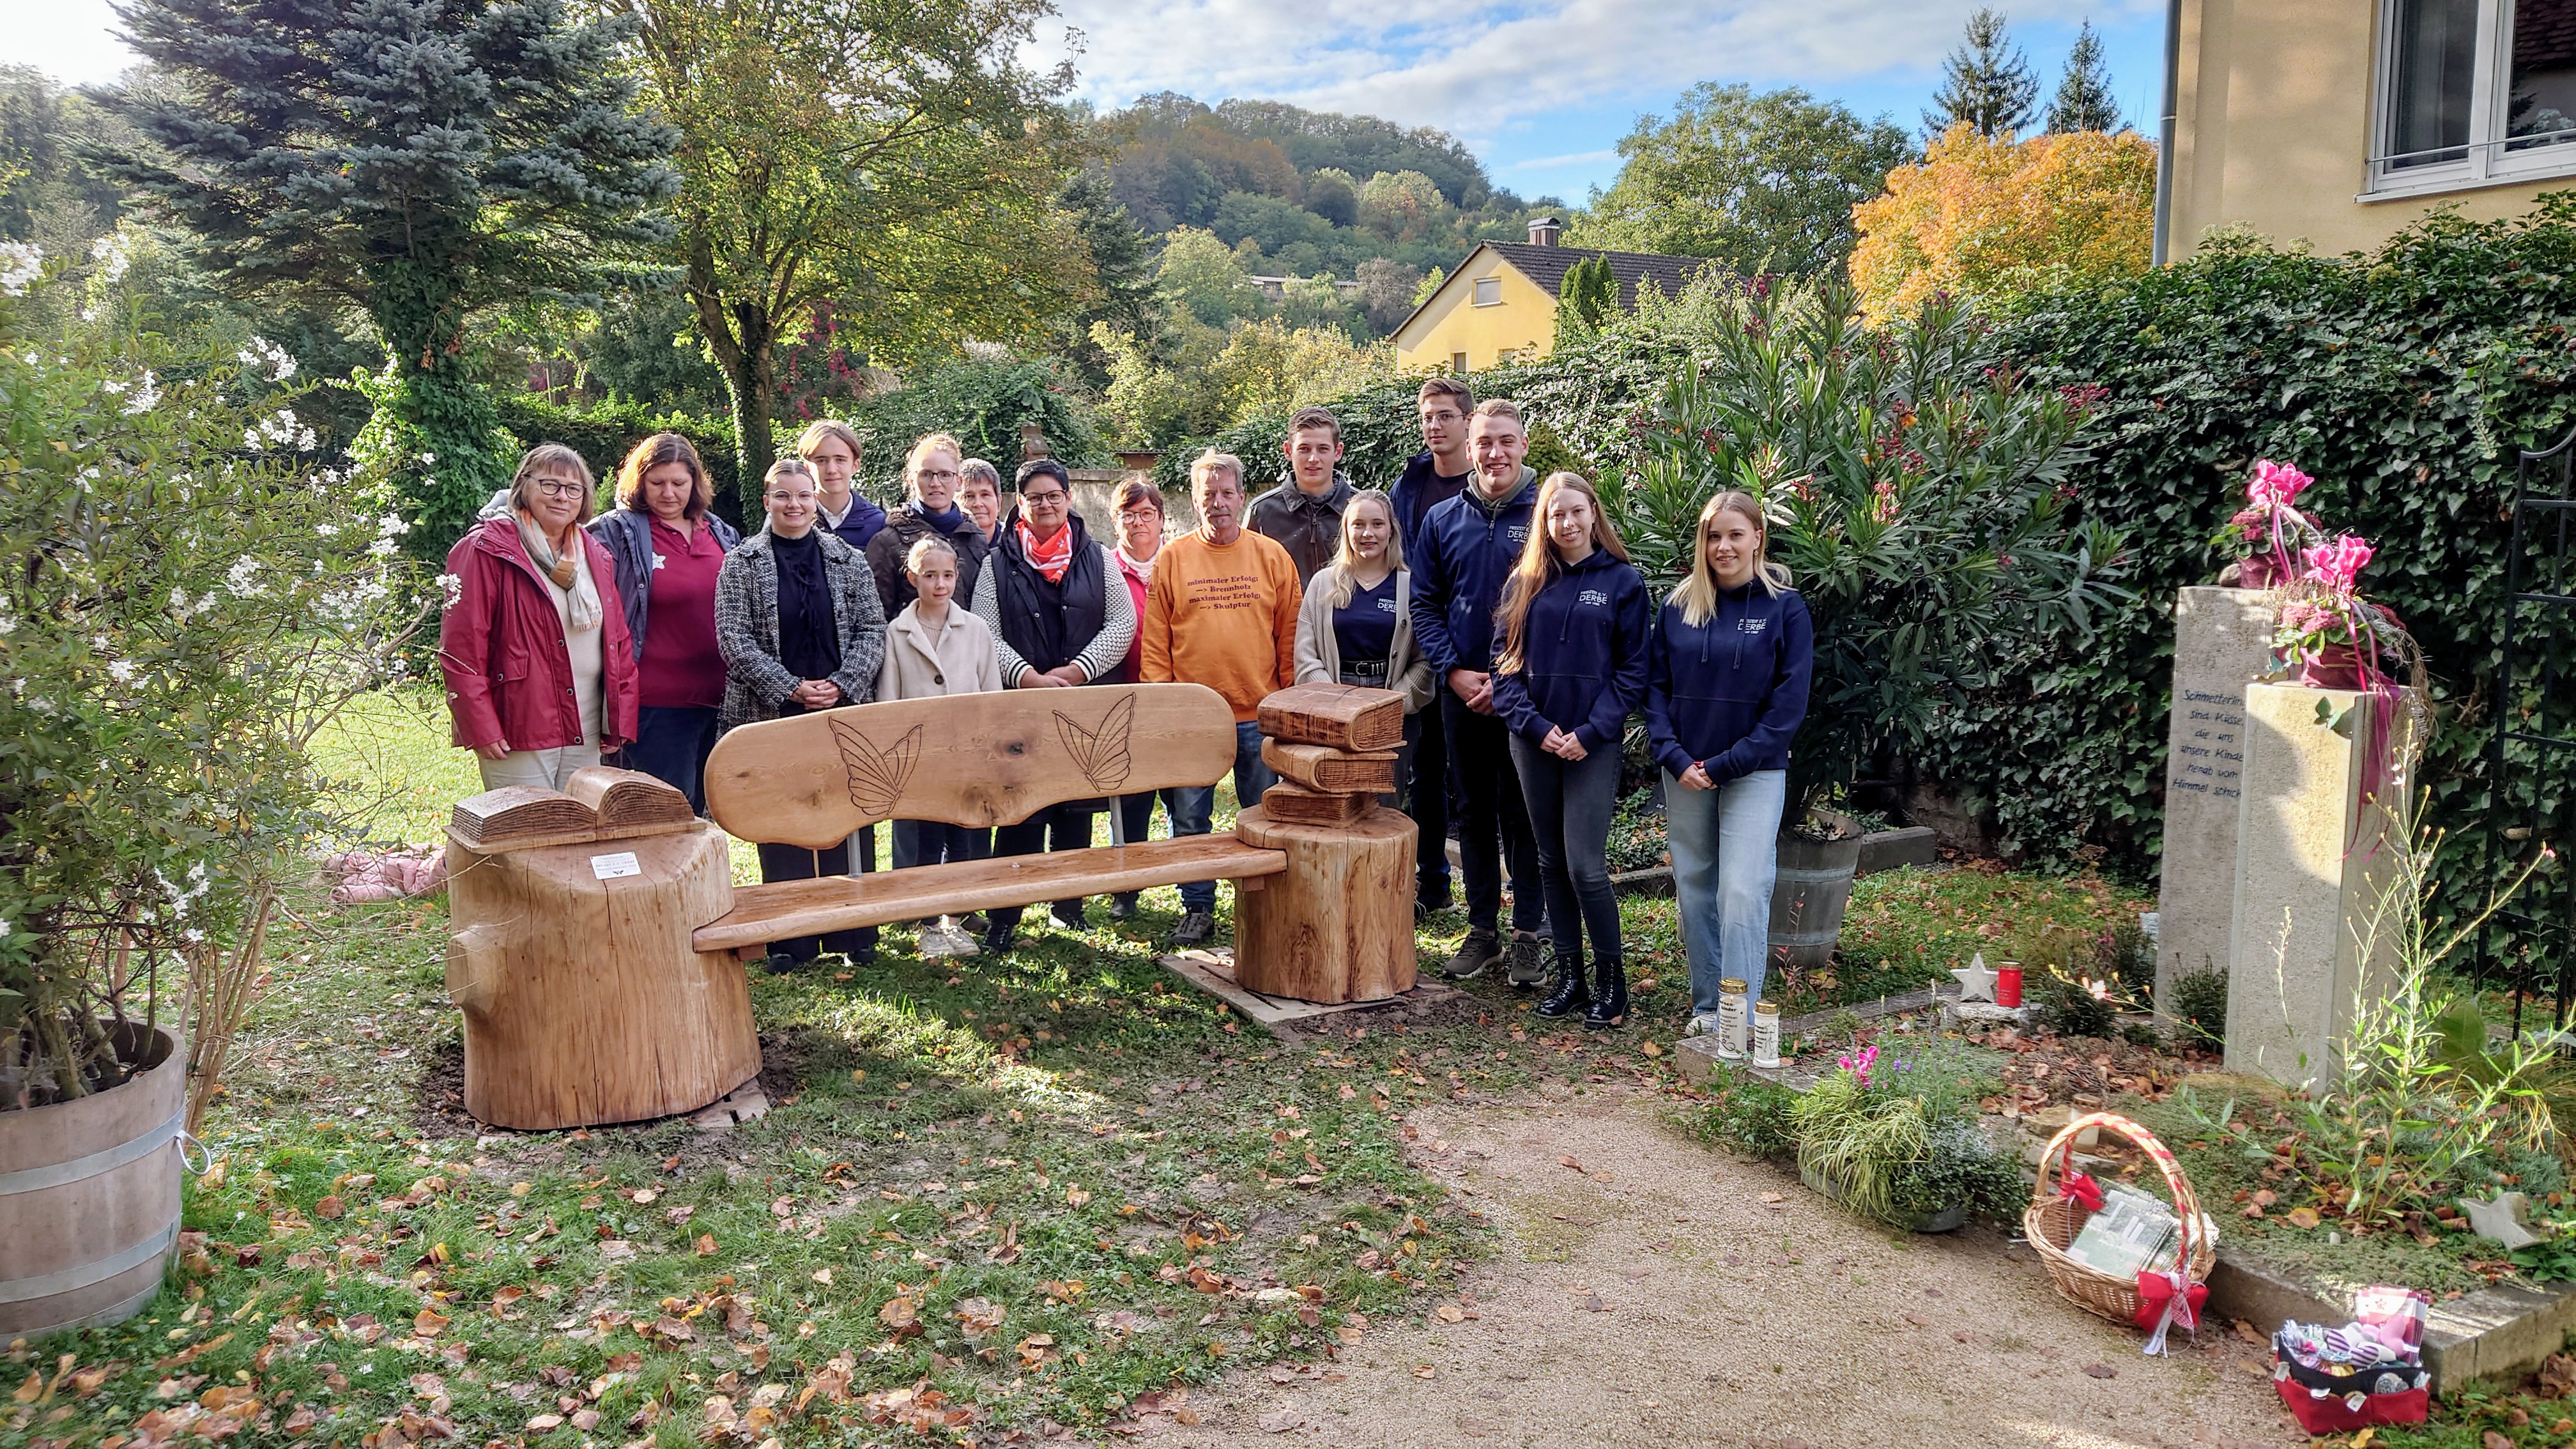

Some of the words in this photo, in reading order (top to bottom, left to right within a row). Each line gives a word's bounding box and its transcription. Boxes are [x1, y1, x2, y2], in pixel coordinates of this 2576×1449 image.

[1507, 530, 1529, 540] DERB
[1187, 578, 1229, 586] minimaler
[1210, 584, 1252, 592] Brennholz
[1189, 595, 1231, 604] maximaler
[1579, 594, 1607, 604] DERBE
[1377, 602, 1397, 610] DERB
[2182, 689, 2243, 706] Schmetterlin
[2195, 728, 2210, 739] die
[2218, 733, 2234, 742] uns
[2181, 746, 2210, 757] unsere
[2214, 748, 2244, 762] Kinde
[2218, 770, 2238, 778] vom
[2172, 778, 2209, 792] Himmel
[2213, 786, 2242, 797] schick
